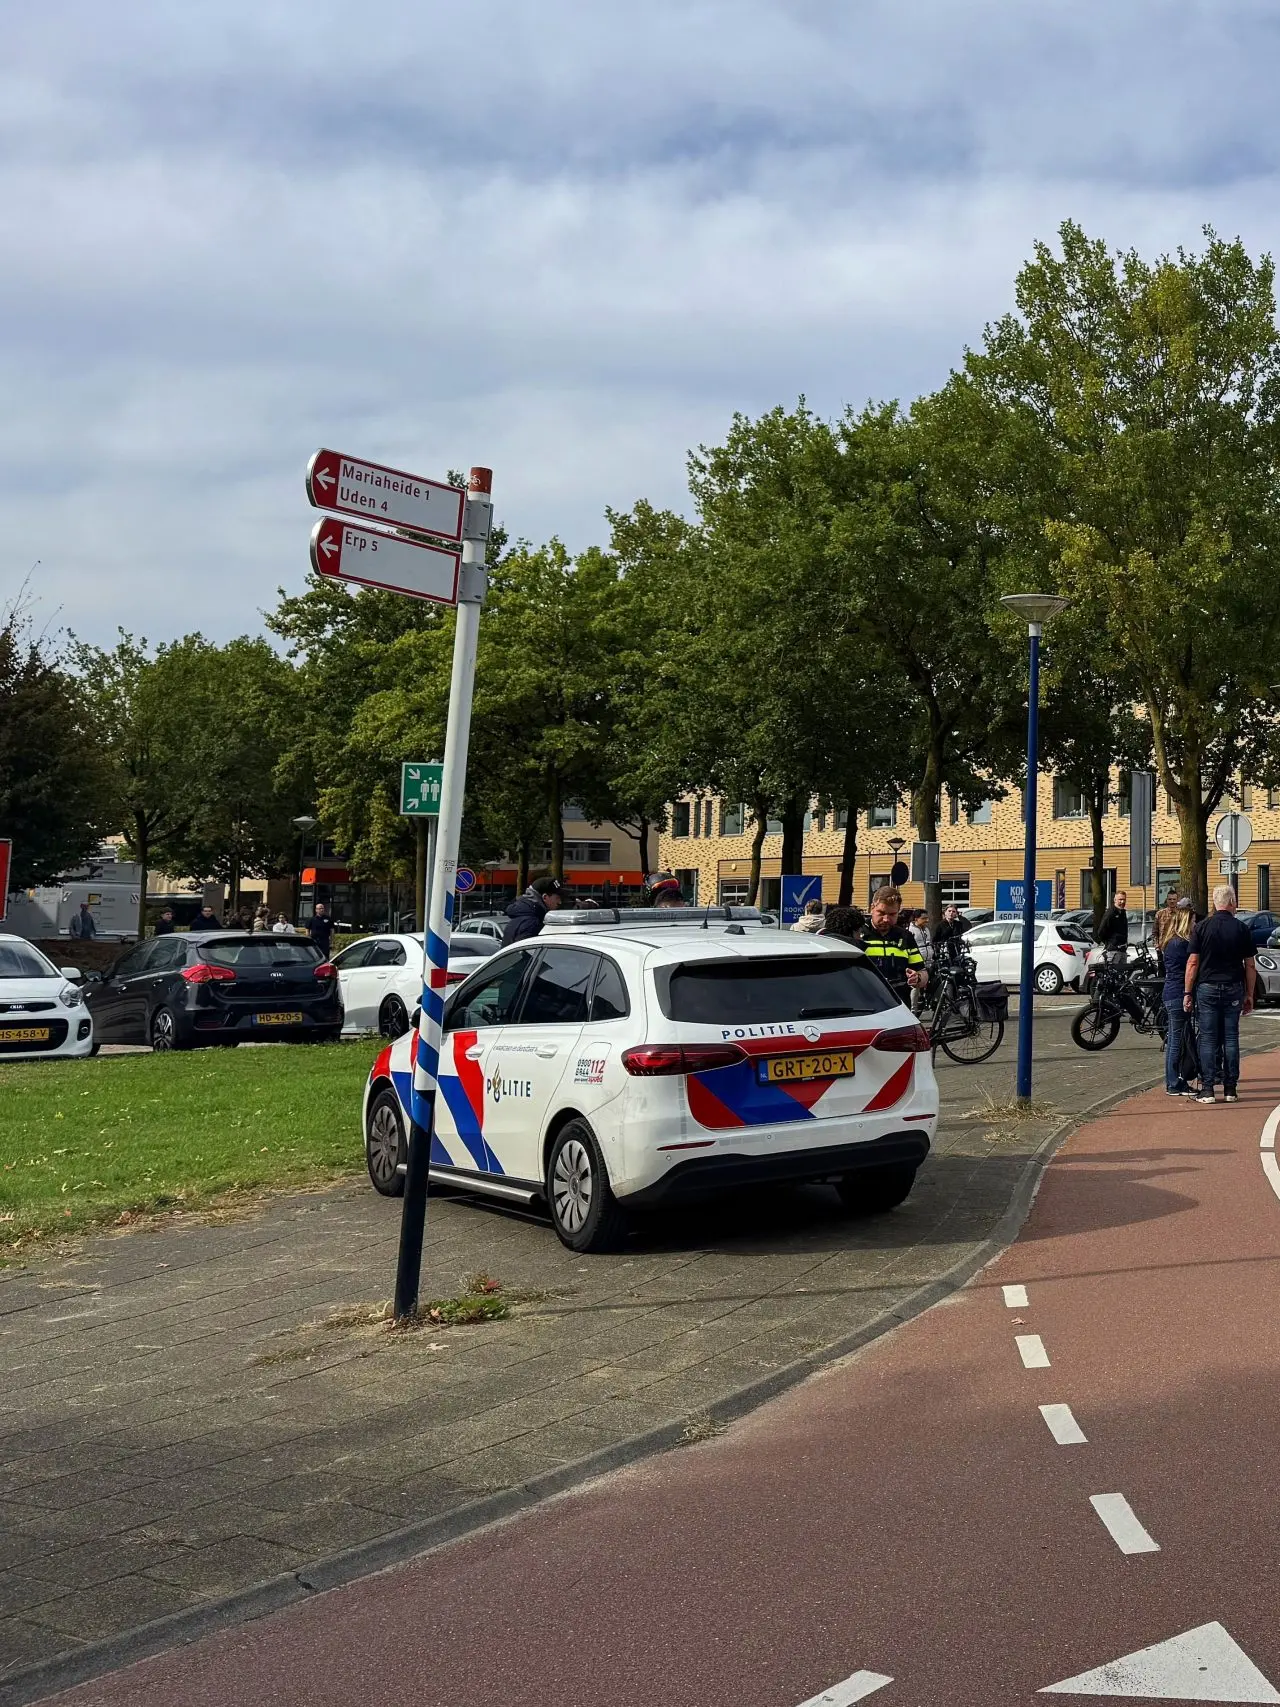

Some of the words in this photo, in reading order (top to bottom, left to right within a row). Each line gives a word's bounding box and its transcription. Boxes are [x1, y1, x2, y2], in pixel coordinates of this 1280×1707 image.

[342, 463, 421, 498] Mariaheide
[425, 489, 430, 500] 1
[340, 486, 376, 509] Uden
[380, 501, 388, 512] 4
[345, 530, 367, 551] Erp
[371, 540, 378, 552] 5
[259, 1013, 301, 1022] HD-420-S
[721, 1024, 796, 1040] POLITIE
[590, 1060, 606, 1074] 112
[773, 1056, 849, 1078] GRT-20-X
